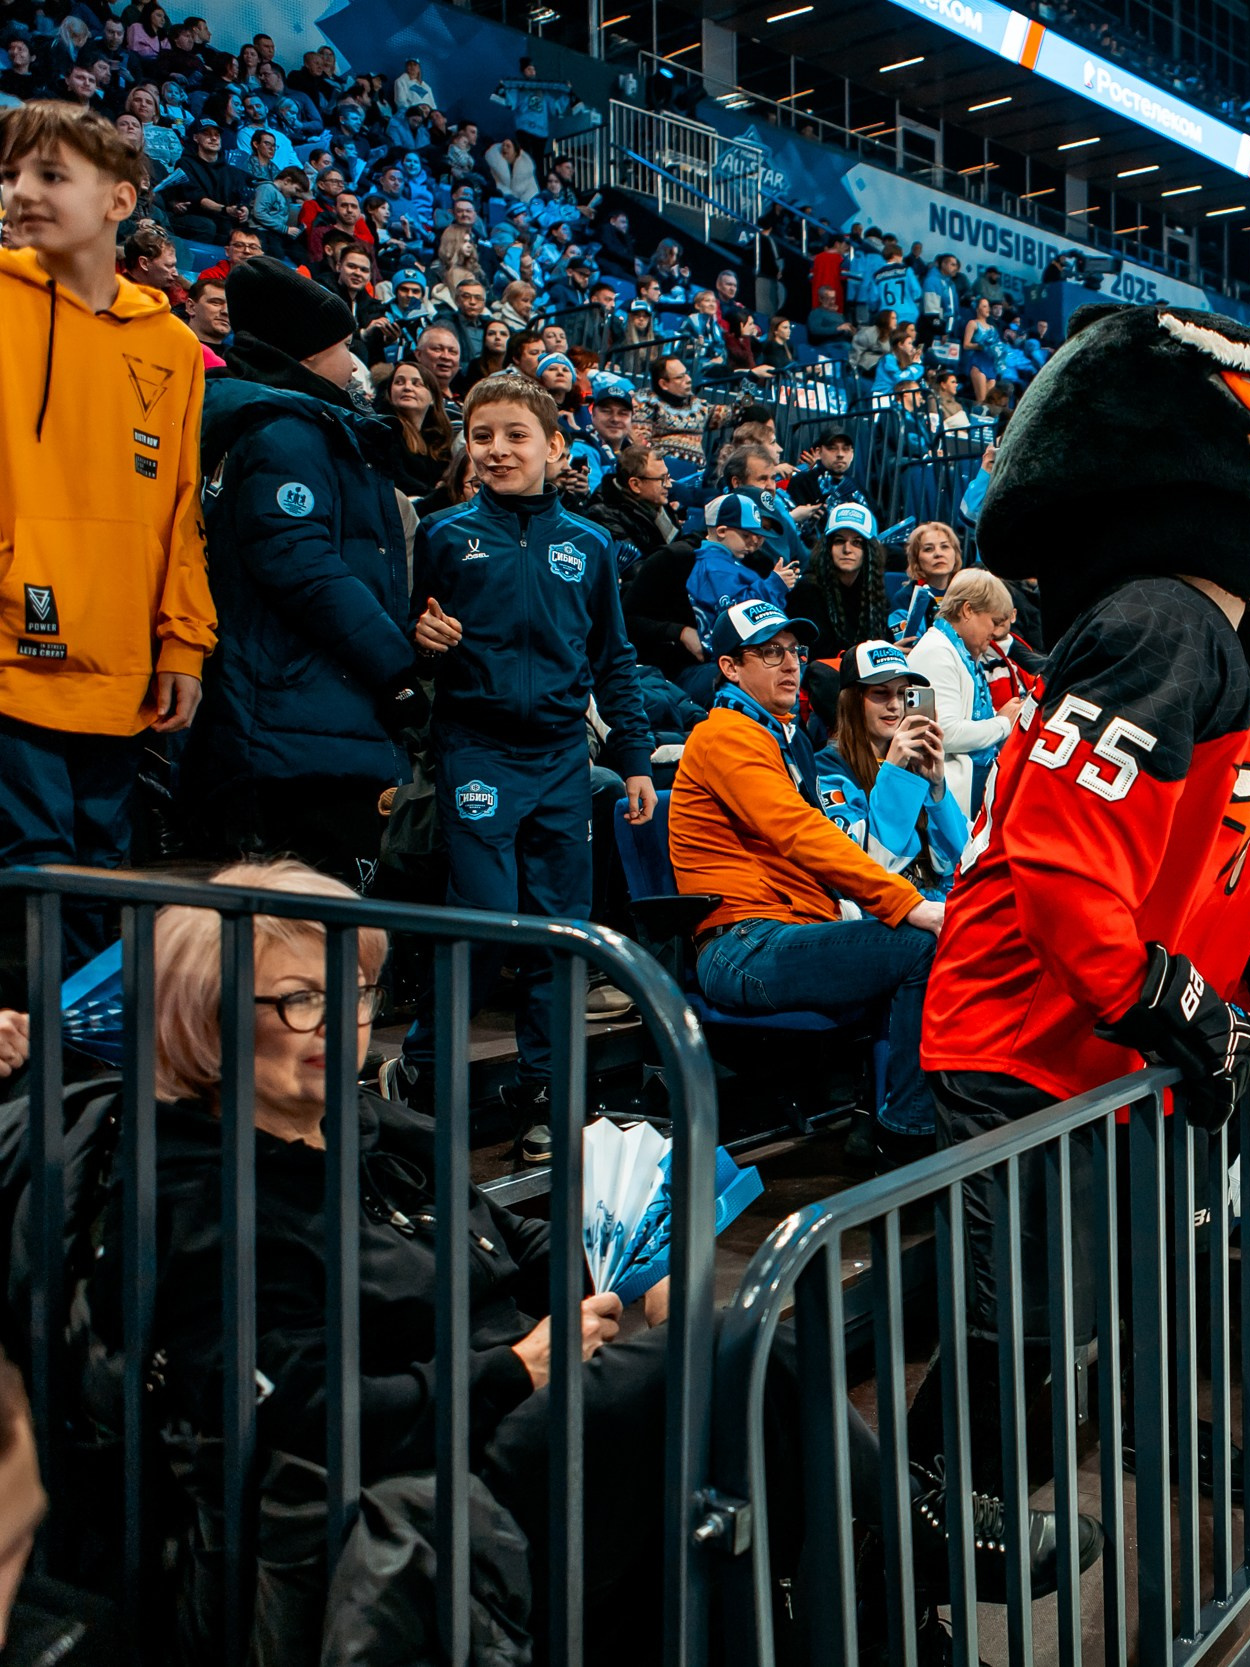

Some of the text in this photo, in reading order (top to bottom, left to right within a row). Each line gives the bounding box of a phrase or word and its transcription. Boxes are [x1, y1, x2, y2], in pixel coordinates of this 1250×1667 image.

[1097, 67, 1202, 143] Ростелеком
[884, 280, 905, 306] 67
[1111, 272, 1157, 303] 2025
[551, 550, 583, 572] СИБИРЬ
[28, 622, 57, 632] POWER
[19, 646, 38, 656] LETS
[1028, 693, 1158, 802] 55
